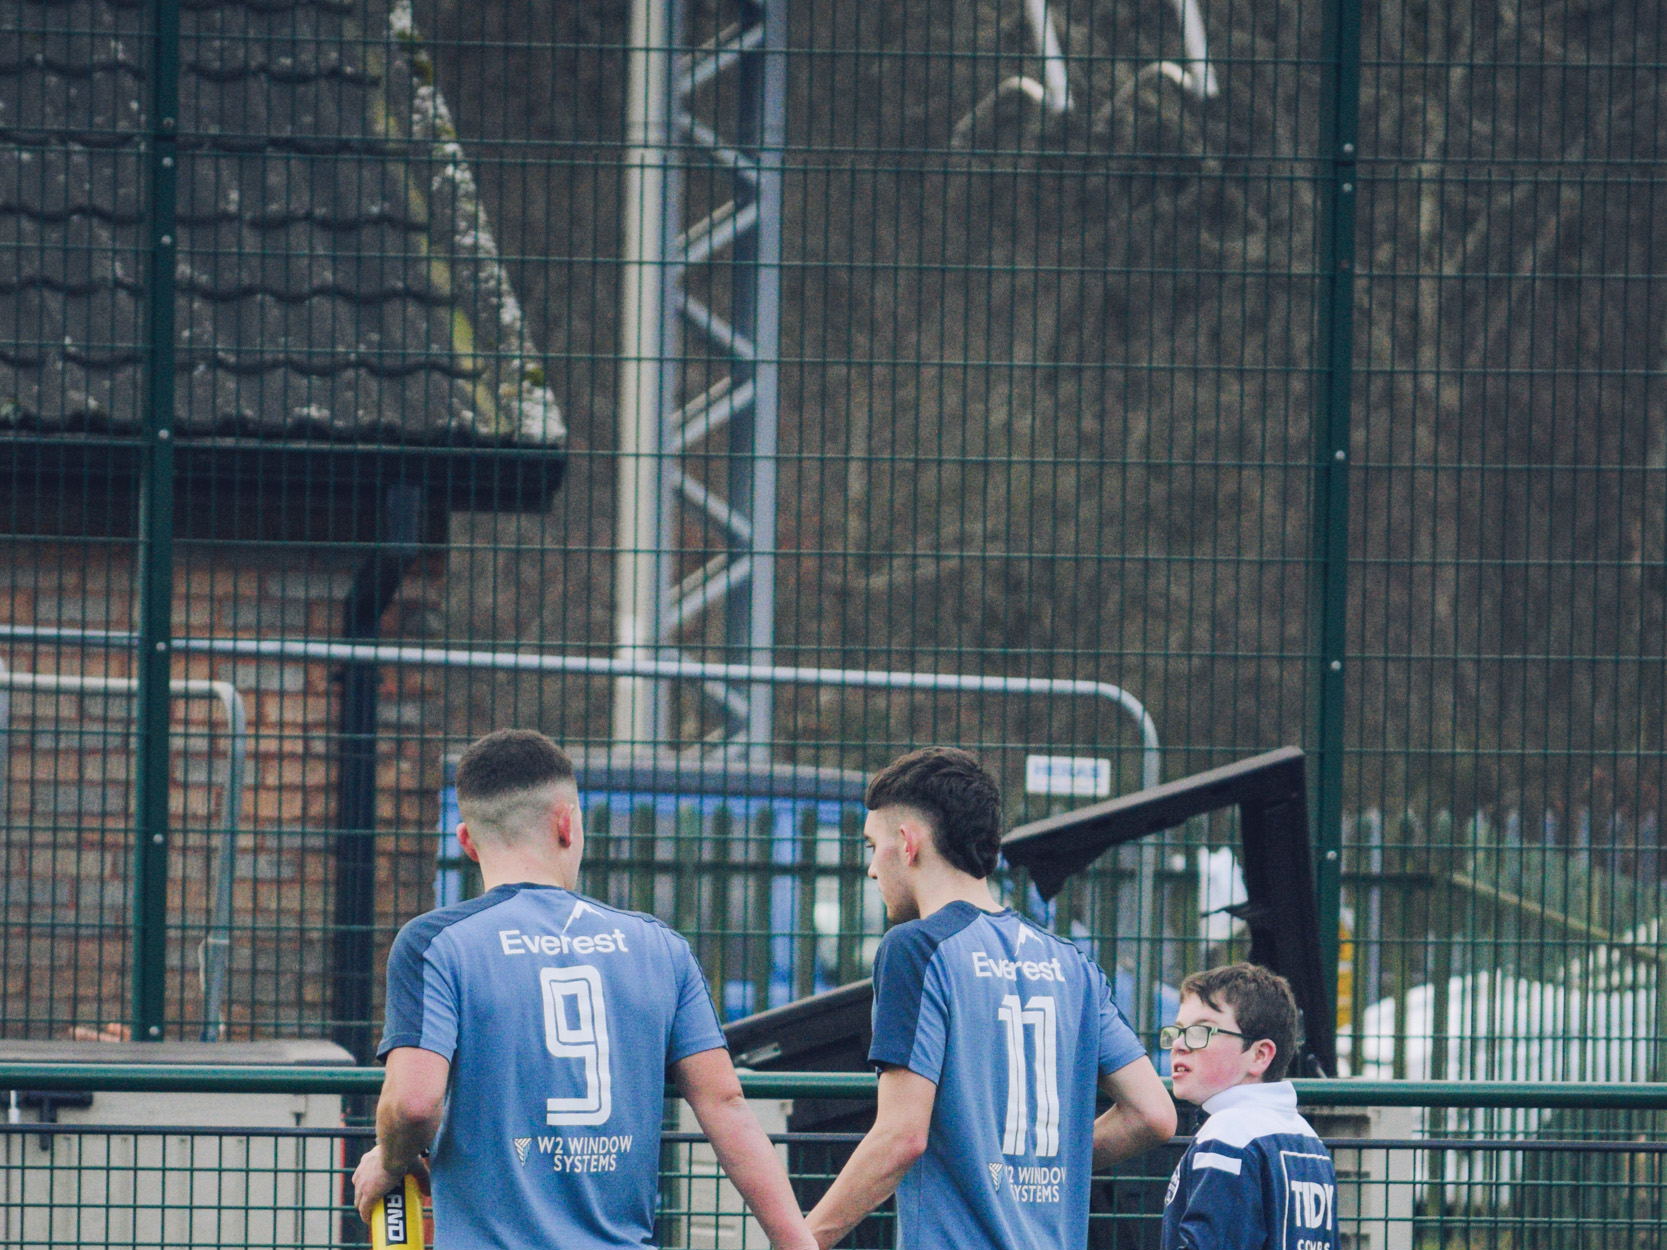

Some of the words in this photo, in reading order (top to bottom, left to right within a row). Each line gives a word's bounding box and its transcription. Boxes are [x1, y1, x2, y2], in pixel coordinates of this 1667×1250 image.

[499, 929, 629, 955] Everest
[972, 952, 1066, 982] Everest
[540, 965, 612, 1126] 9
[998, 994, 1060, 1158] 11
[537, 1136, 563, 1155] W2
[568, 1135, 633, 1155] WINDOW
[553, 1154, 617, 1173] SYSTEMS
[1291, 1180, 1334, 1231] TIDY
